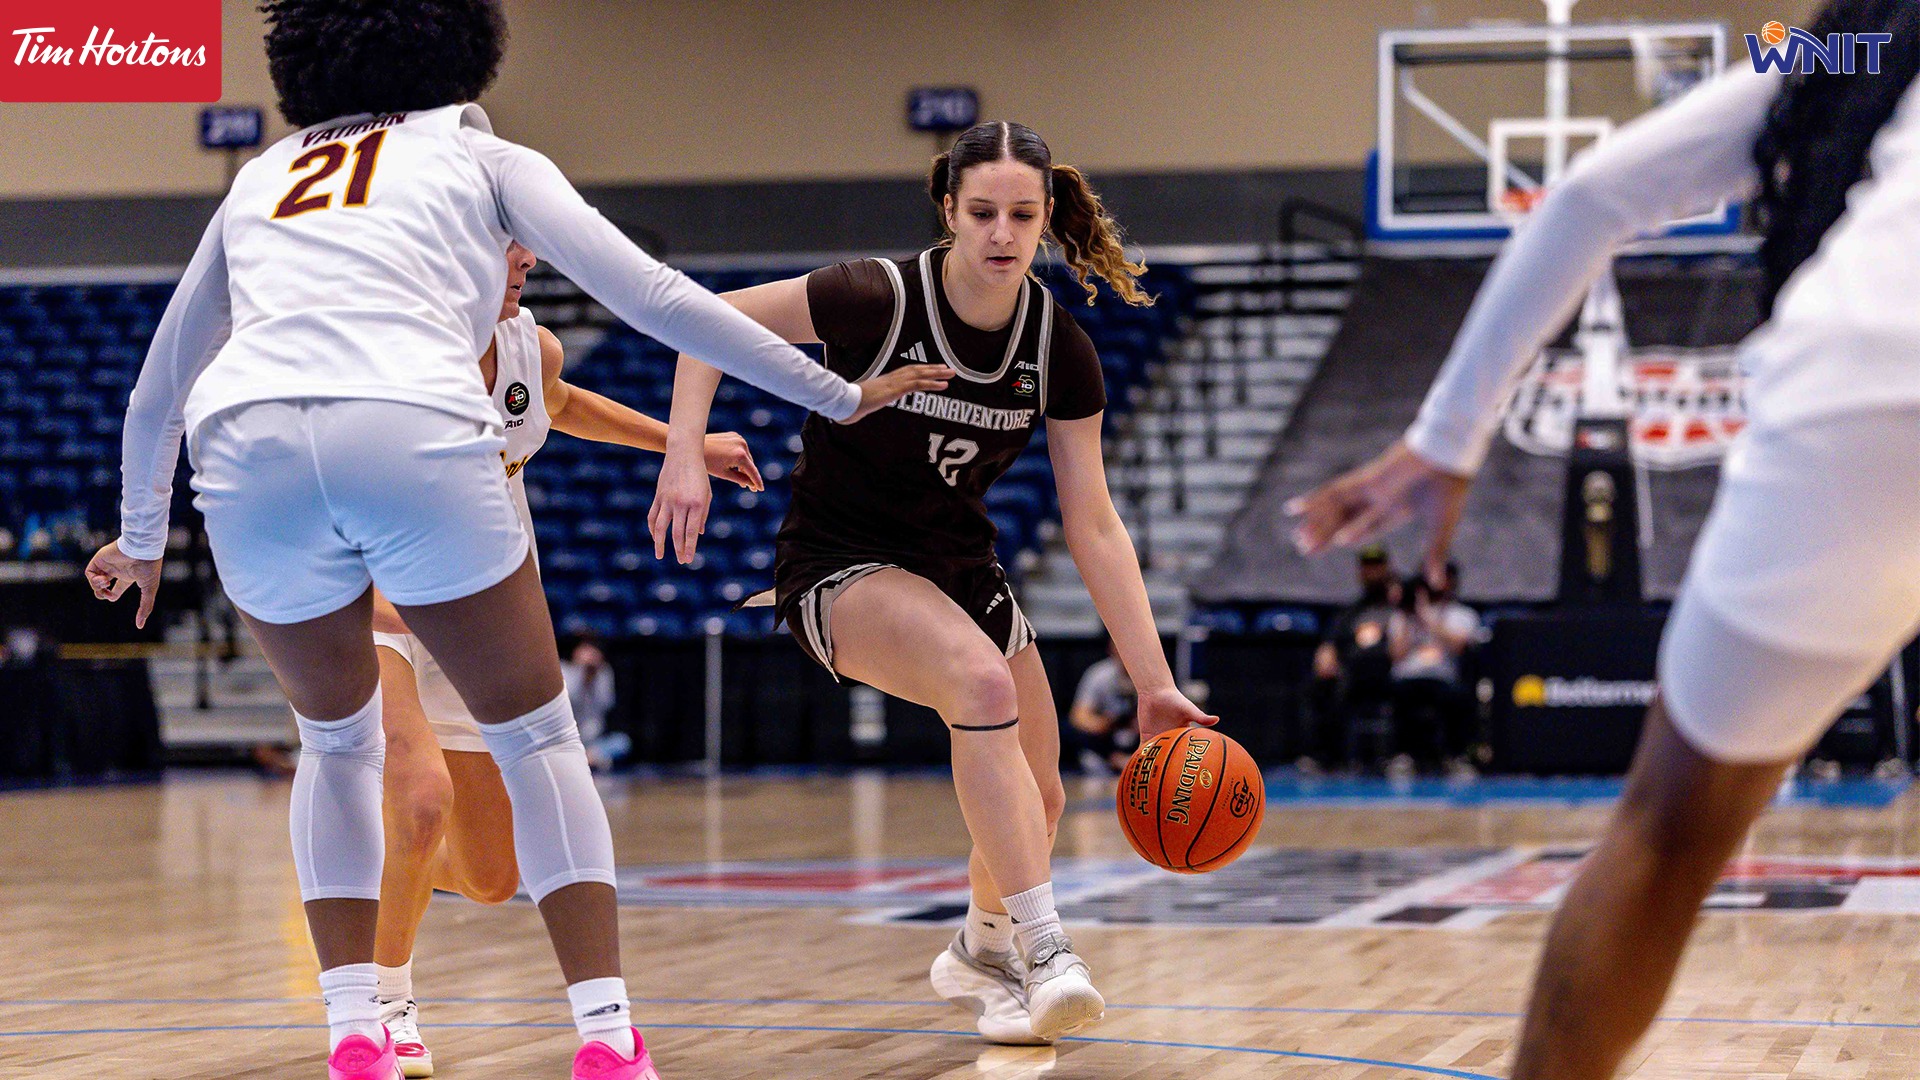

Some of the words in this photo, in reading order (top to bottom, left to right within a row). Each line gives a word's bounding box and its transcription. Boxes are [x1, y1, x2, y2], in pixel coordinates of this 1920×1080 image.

[270, 128, 390, 220] 21
[505, 418, 524, 430] A10
[928, 432, 980, 487] 12
[1138, 737, 1170, 816] LEGACY
[1167, 735, 1211, 826] SPALDING
